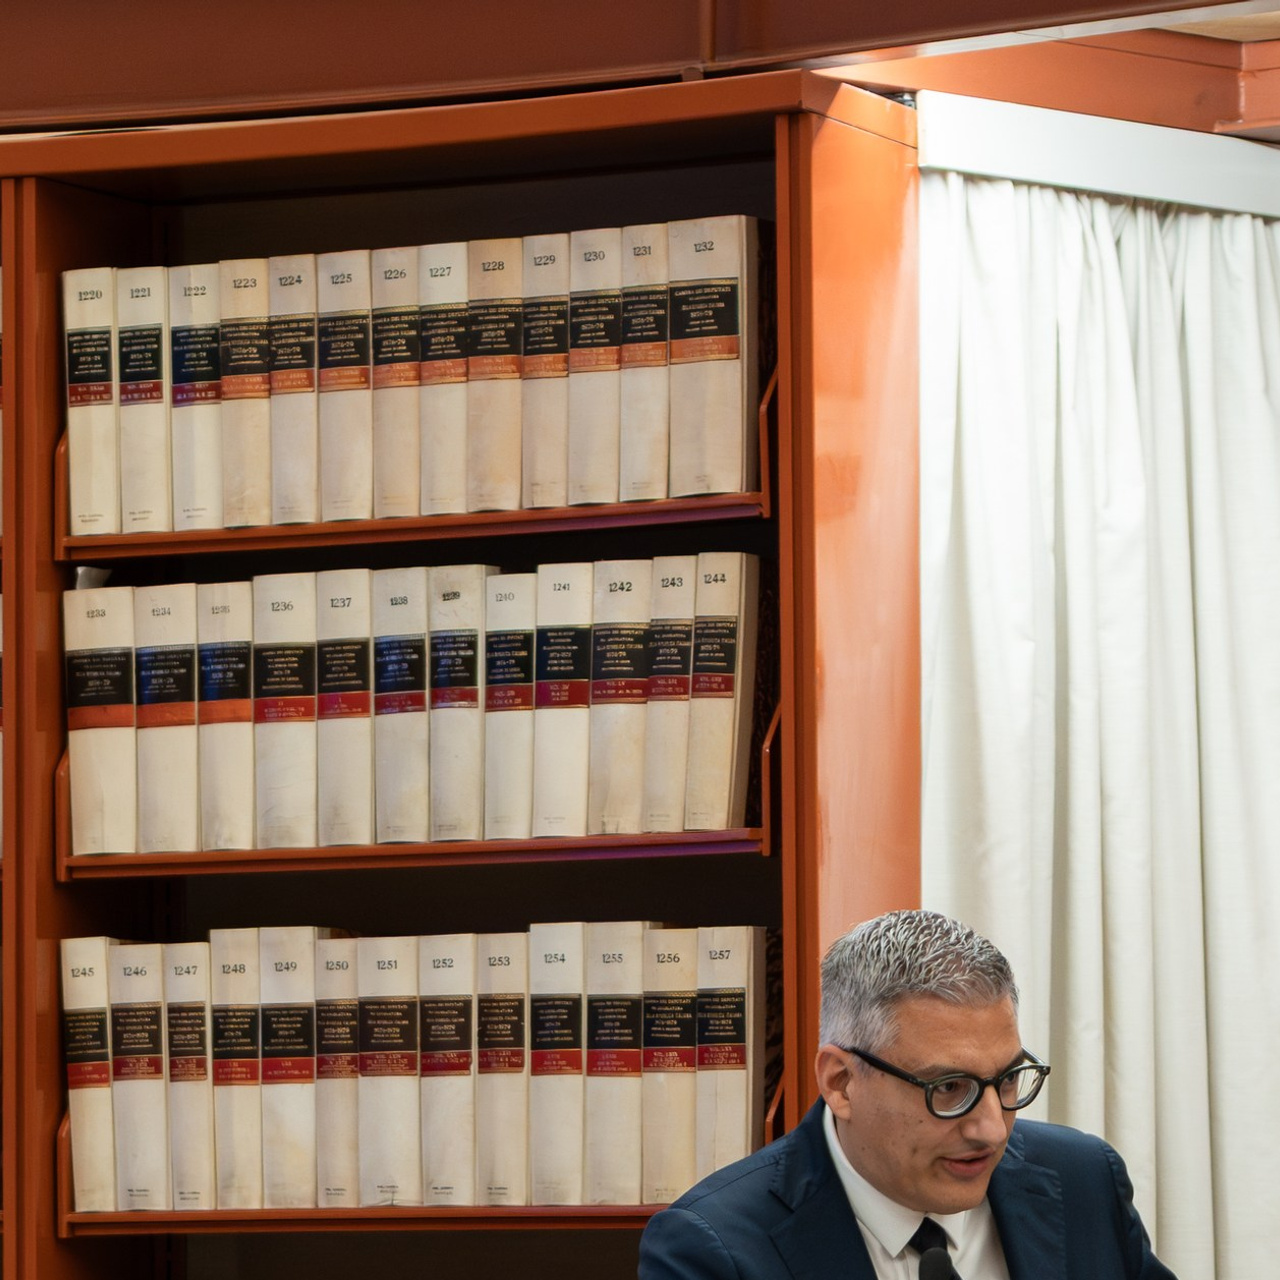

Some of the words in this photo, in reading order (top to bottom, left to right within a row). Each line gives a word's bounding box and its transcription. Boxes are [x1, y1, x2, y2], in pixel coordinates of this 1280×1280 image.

[633, 246, 652, 256] 1231
[694, 241, 714, 252] 1232
[533, 255, 556, 266] 1229
[584, 251, 605, 262] 1230
[482, 261, 505, 272] 1228
[384, 269, 407, 280] 1226
[429, 267, 452, 277] 1227
[233, 278, 257, 289] 1223
[279, 275, 303, 286] 1224
[331, 274, 352, 284] 1225
[78, 290, 103, 301] 1220
[130, 288, 151, 298] 1221
[183, 286, 207, 297] 1222
[661, 577, 683, 588] 1243
[704, 573, 727, 584] 1244
[553, 583, 570, 592] 1241
[609, 582, 632, 592] 1242
[390, 596, 408, 606] 1238
[441, 591, 461, 601] 1239
[495, 593, 515, 602] 1240
[271, 601, 294, 612] 1236
[330, 598, 352, 608] 1237
[86, 609, 106, 618] 1233
[151, 607, 171, 616] 1234
[544, 953, 566, 964] 1254
[602, 953, 623, 964] 1255
[656, 953, 680, 964] 1256
[709, 950, 731, 960] 1257
[325, 960, 349, 971] 1250
[377, 960, 398, 970] 1251
[432, 959, 454, 969] 1252
[488, 956, 511, 966] 1253
[123, 967, 147, 976] 1246
[174, 966, 198, 976] 1247
[222, 964, 246, 974] 1248
[274, 961, 297, 972] 1249
[71, 967, 95, 978] 1245
